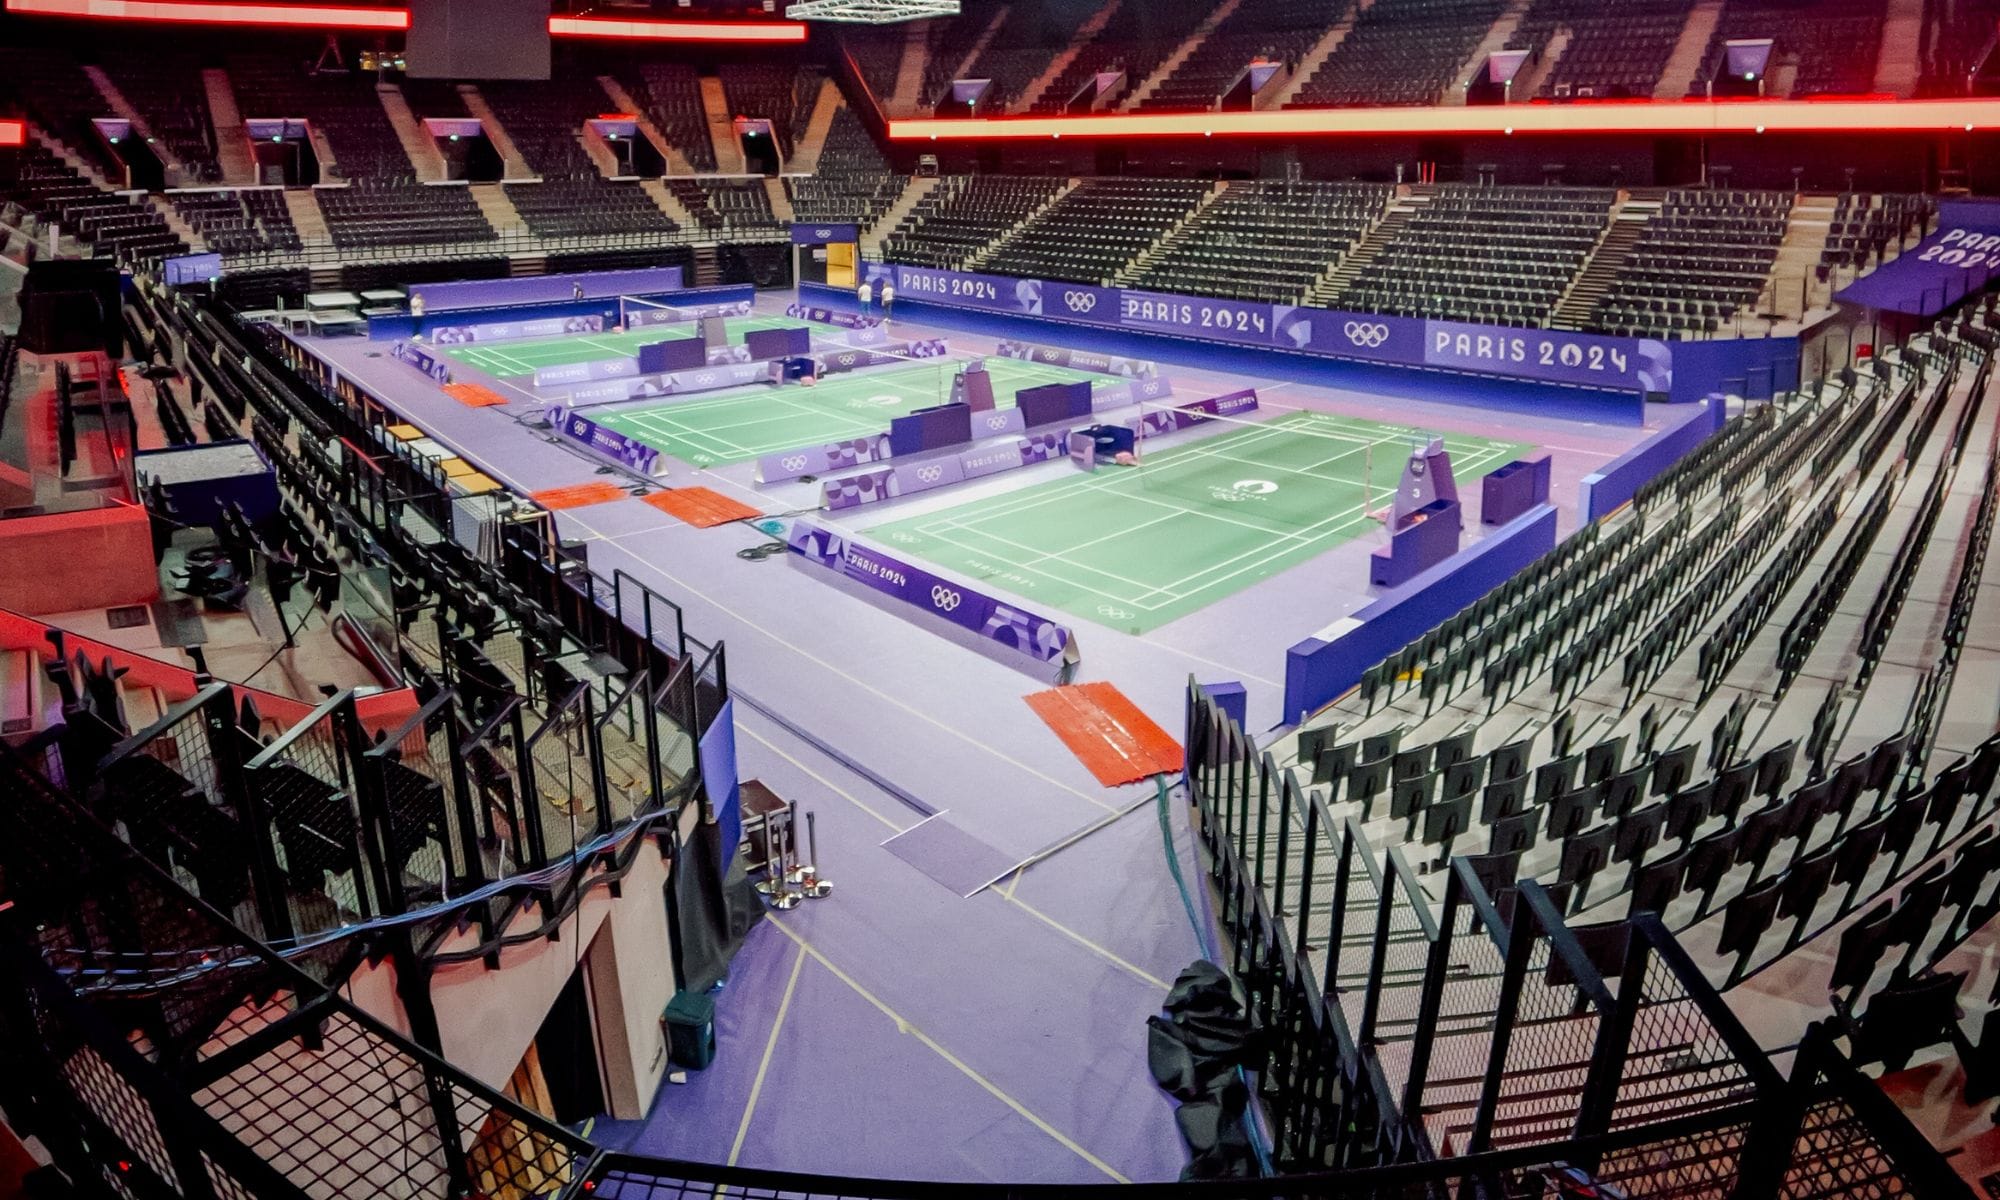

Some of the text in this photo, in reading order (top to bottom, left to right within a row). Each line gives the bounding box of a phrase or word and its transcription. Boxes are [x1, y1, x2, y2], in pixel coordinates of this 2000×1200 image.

[1918, 245, 2000, 269] 2024
[951, 279, 995, 300] 2024
[1201, 307, 1265, 333] 2024
[1539, 341, 1627, 374] 2024
[1412, 488, 1420, 498] 3
[880, 567, 906, 587] 2024
